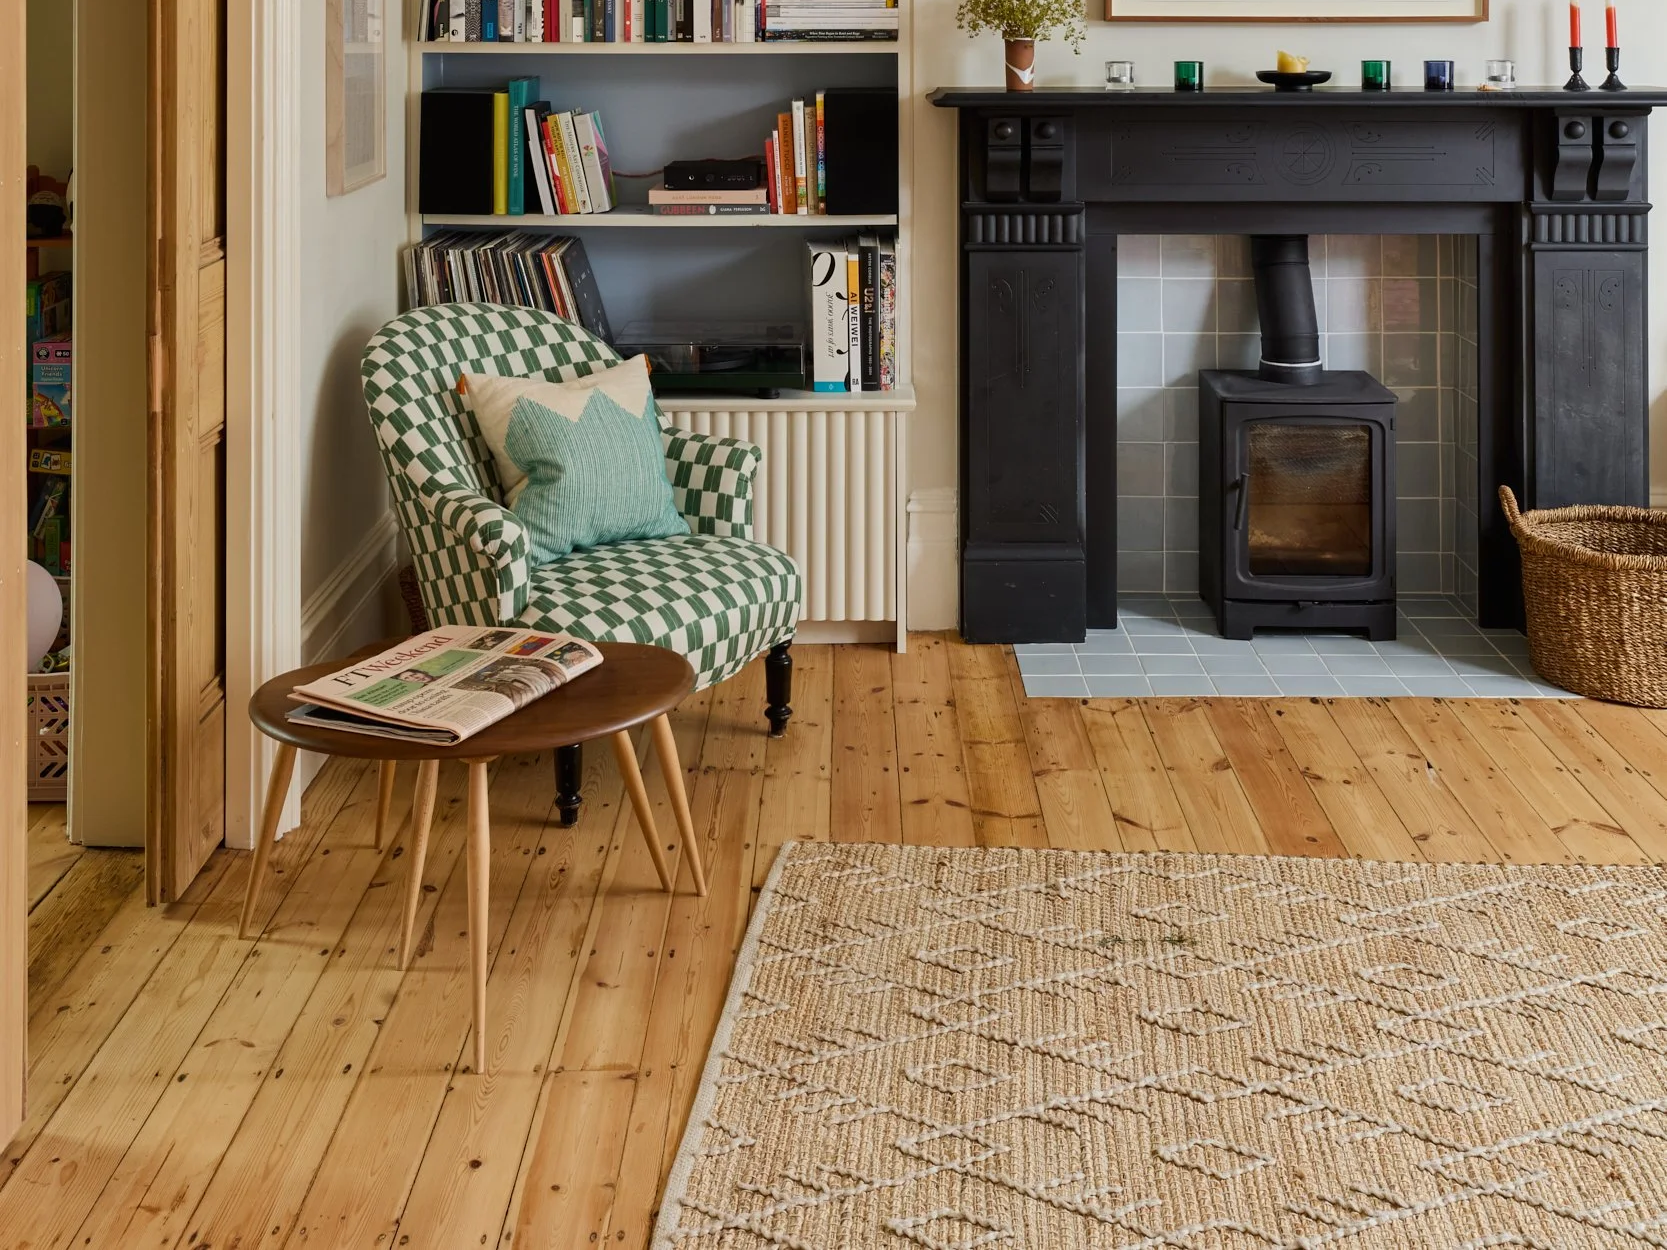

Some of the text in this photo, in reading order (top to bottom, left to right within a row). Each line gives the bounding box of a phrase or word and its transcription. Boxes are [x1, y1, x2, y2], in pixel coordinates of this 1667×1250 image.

[661, 206, 705, 214] GUBBEEN
[850, 292, 858, 302] AI
[826, 318, 834, 336] years
[828, 337, 836, 345] of
